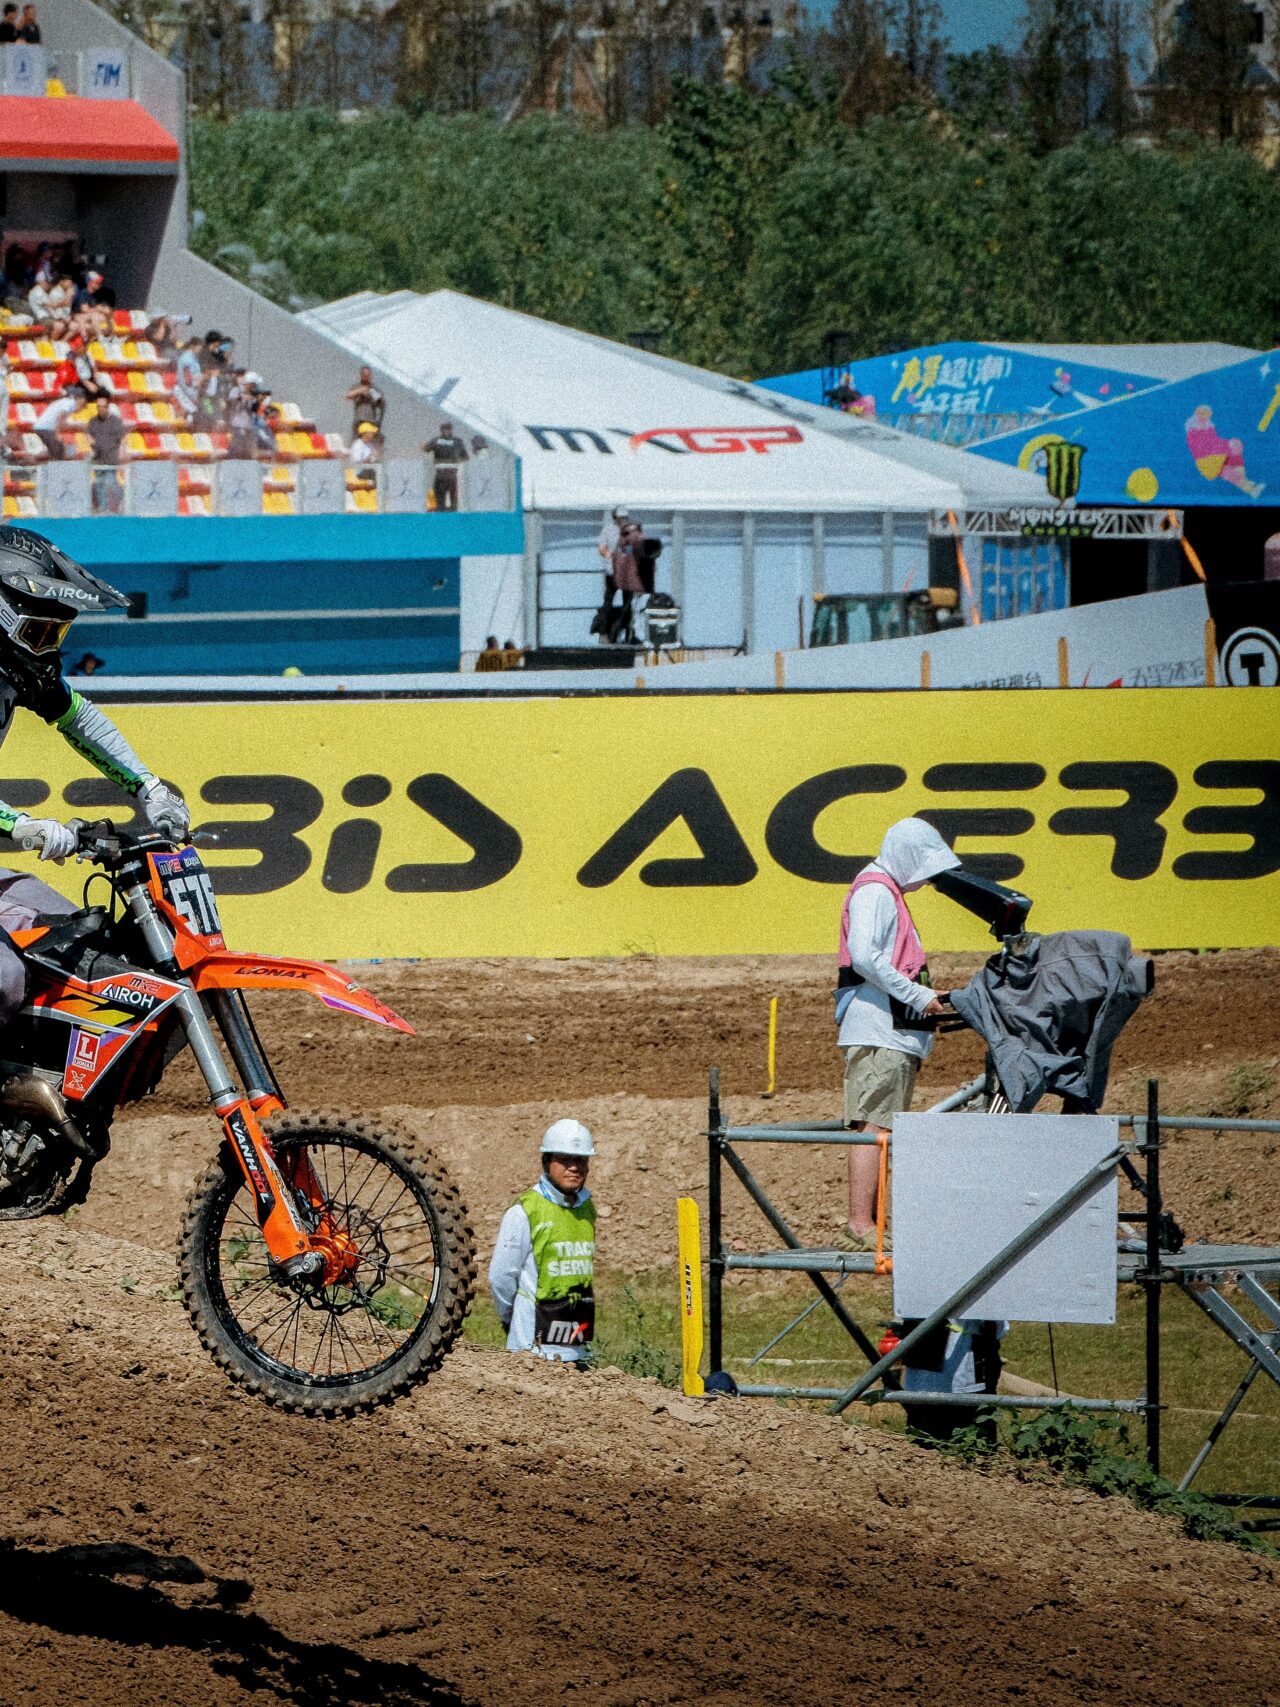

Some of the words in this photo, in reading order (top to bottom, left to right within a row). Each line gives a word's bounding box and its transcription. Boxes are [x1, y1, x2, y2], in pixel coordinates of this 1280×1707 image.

[522, 425, 804, 455] MXGP
[44, 586, 100, 602] AIROH
[101, 984, 155, 1010] AIROH
[129, 977, 161, 994] MX2
[78, 1036, 93, 1060] L
